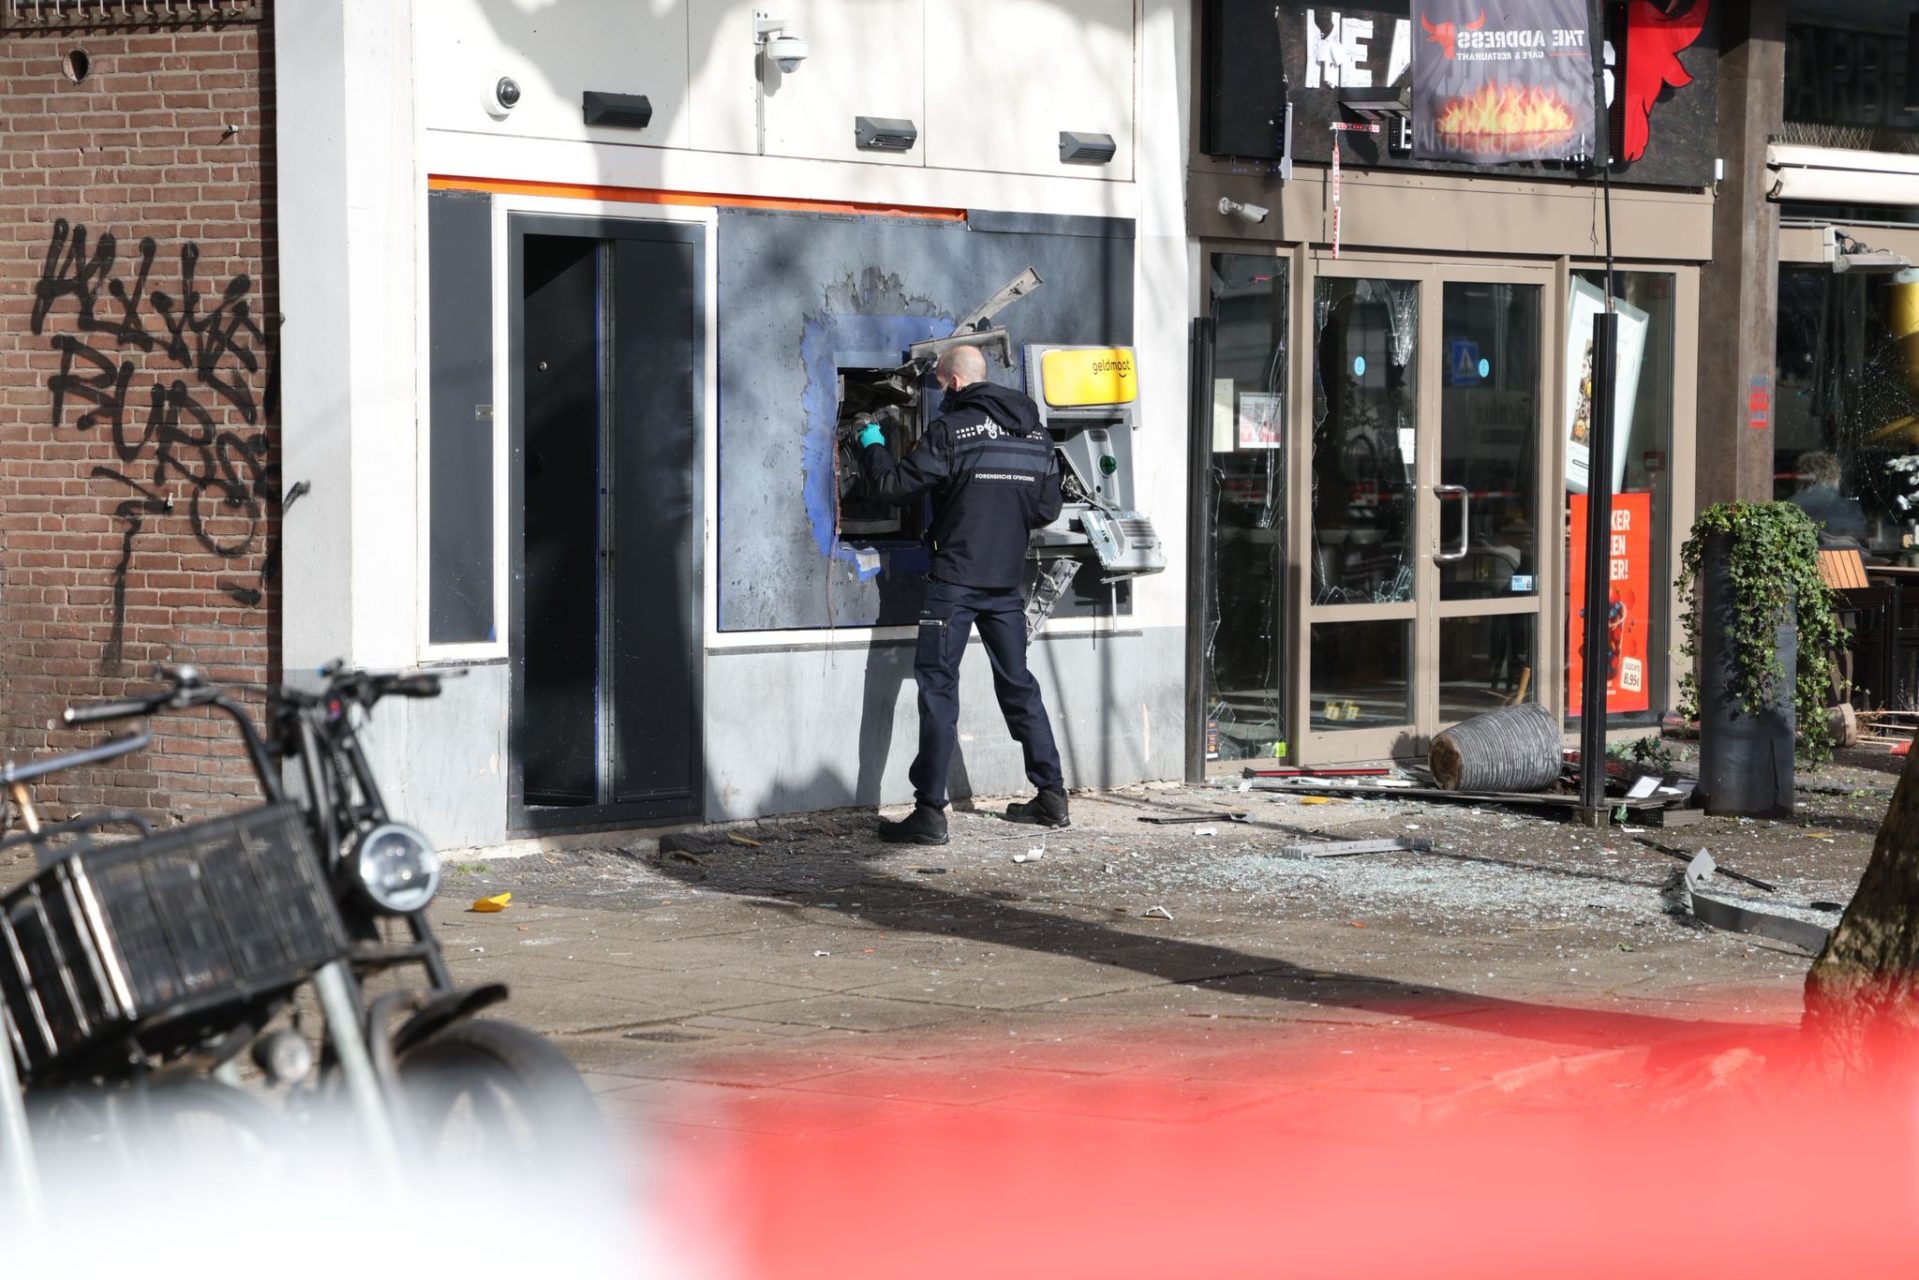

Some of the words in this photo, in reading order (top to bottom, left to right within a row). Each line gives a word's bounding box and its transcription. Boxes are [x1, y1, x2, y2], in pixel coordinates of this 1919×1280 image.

[1092, 359, 1131, 376] geldmaat
[974, 473, 1012, 481] FORENSISCHE
[1611, 509, 1631, 532] KER
[1610, 534, 1626, 556] EN
[1609, 559, 1629, 581] ER!
